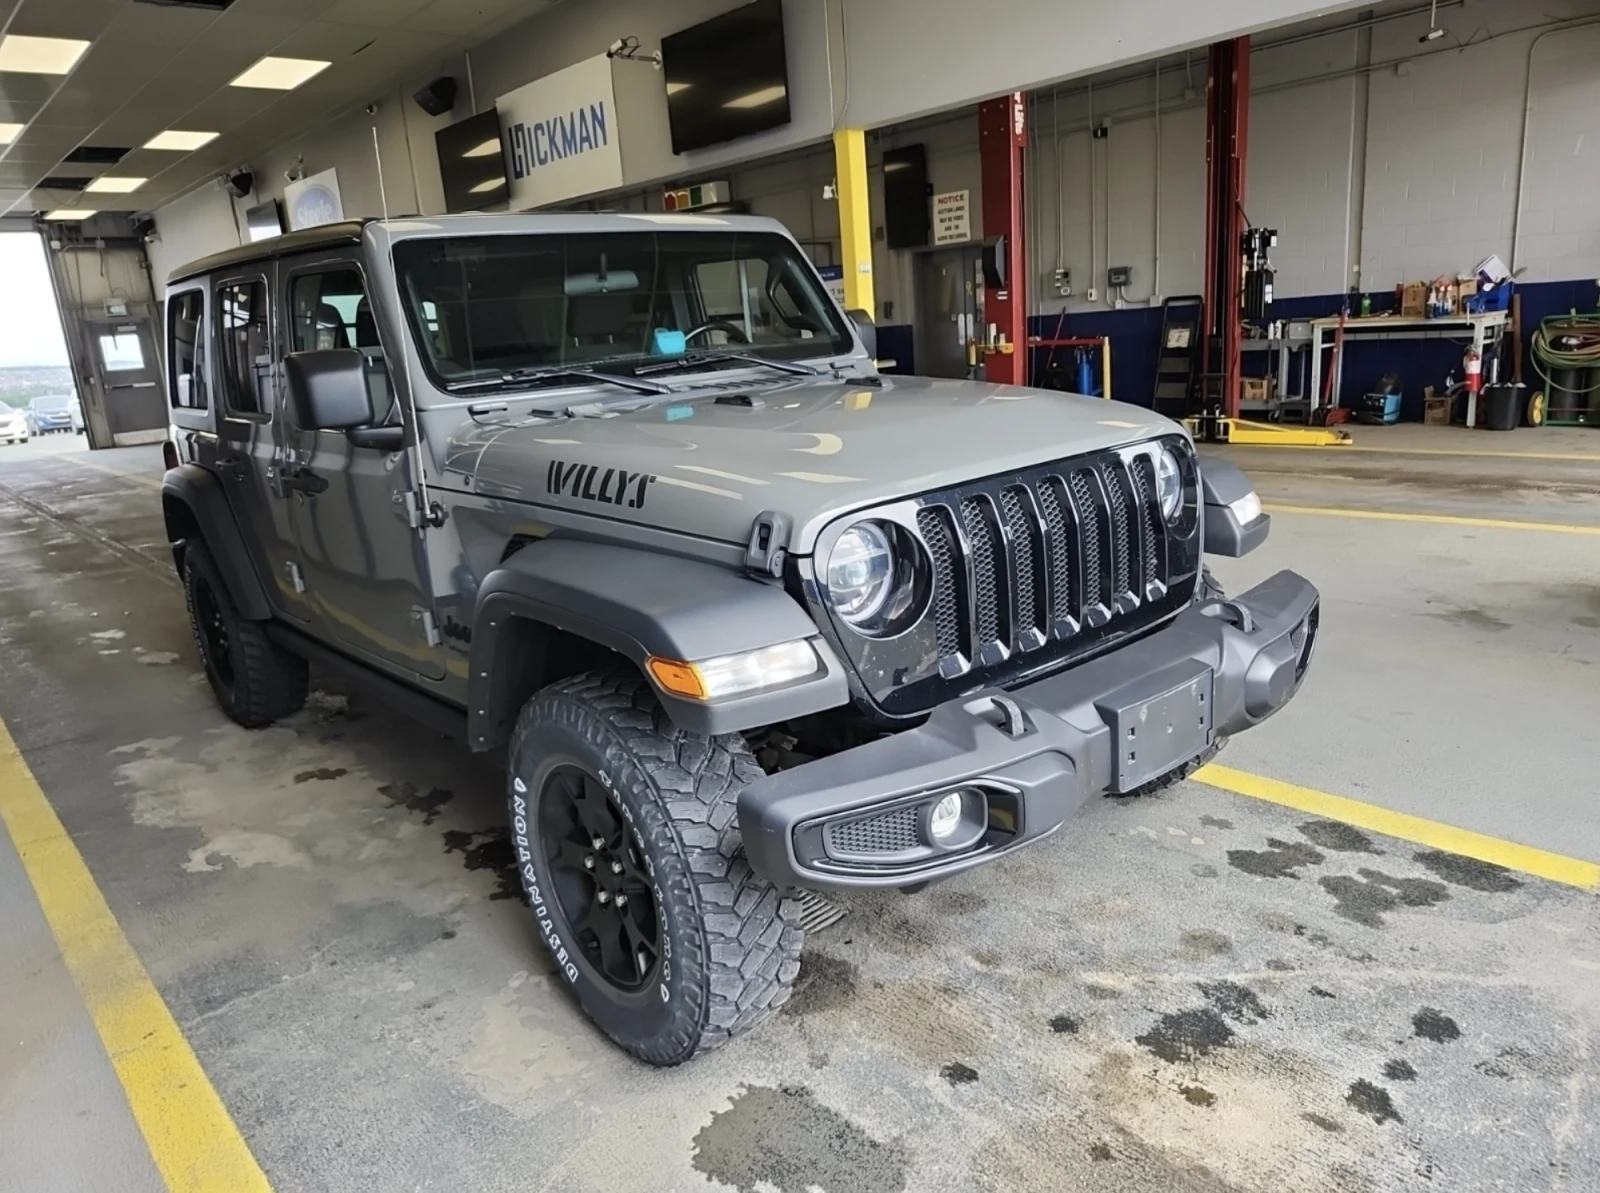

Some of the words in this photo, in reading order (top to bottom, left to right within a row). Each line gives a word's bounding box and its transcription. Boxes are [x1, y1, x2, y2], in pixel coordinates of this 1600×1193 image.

[508, 101, 608, 180] HICKMAN
[937, 194, 965, 205] NOTICE
[547, 460, 657, 510] WILLYS
[512, 799, 580, 984] DESTINATION
